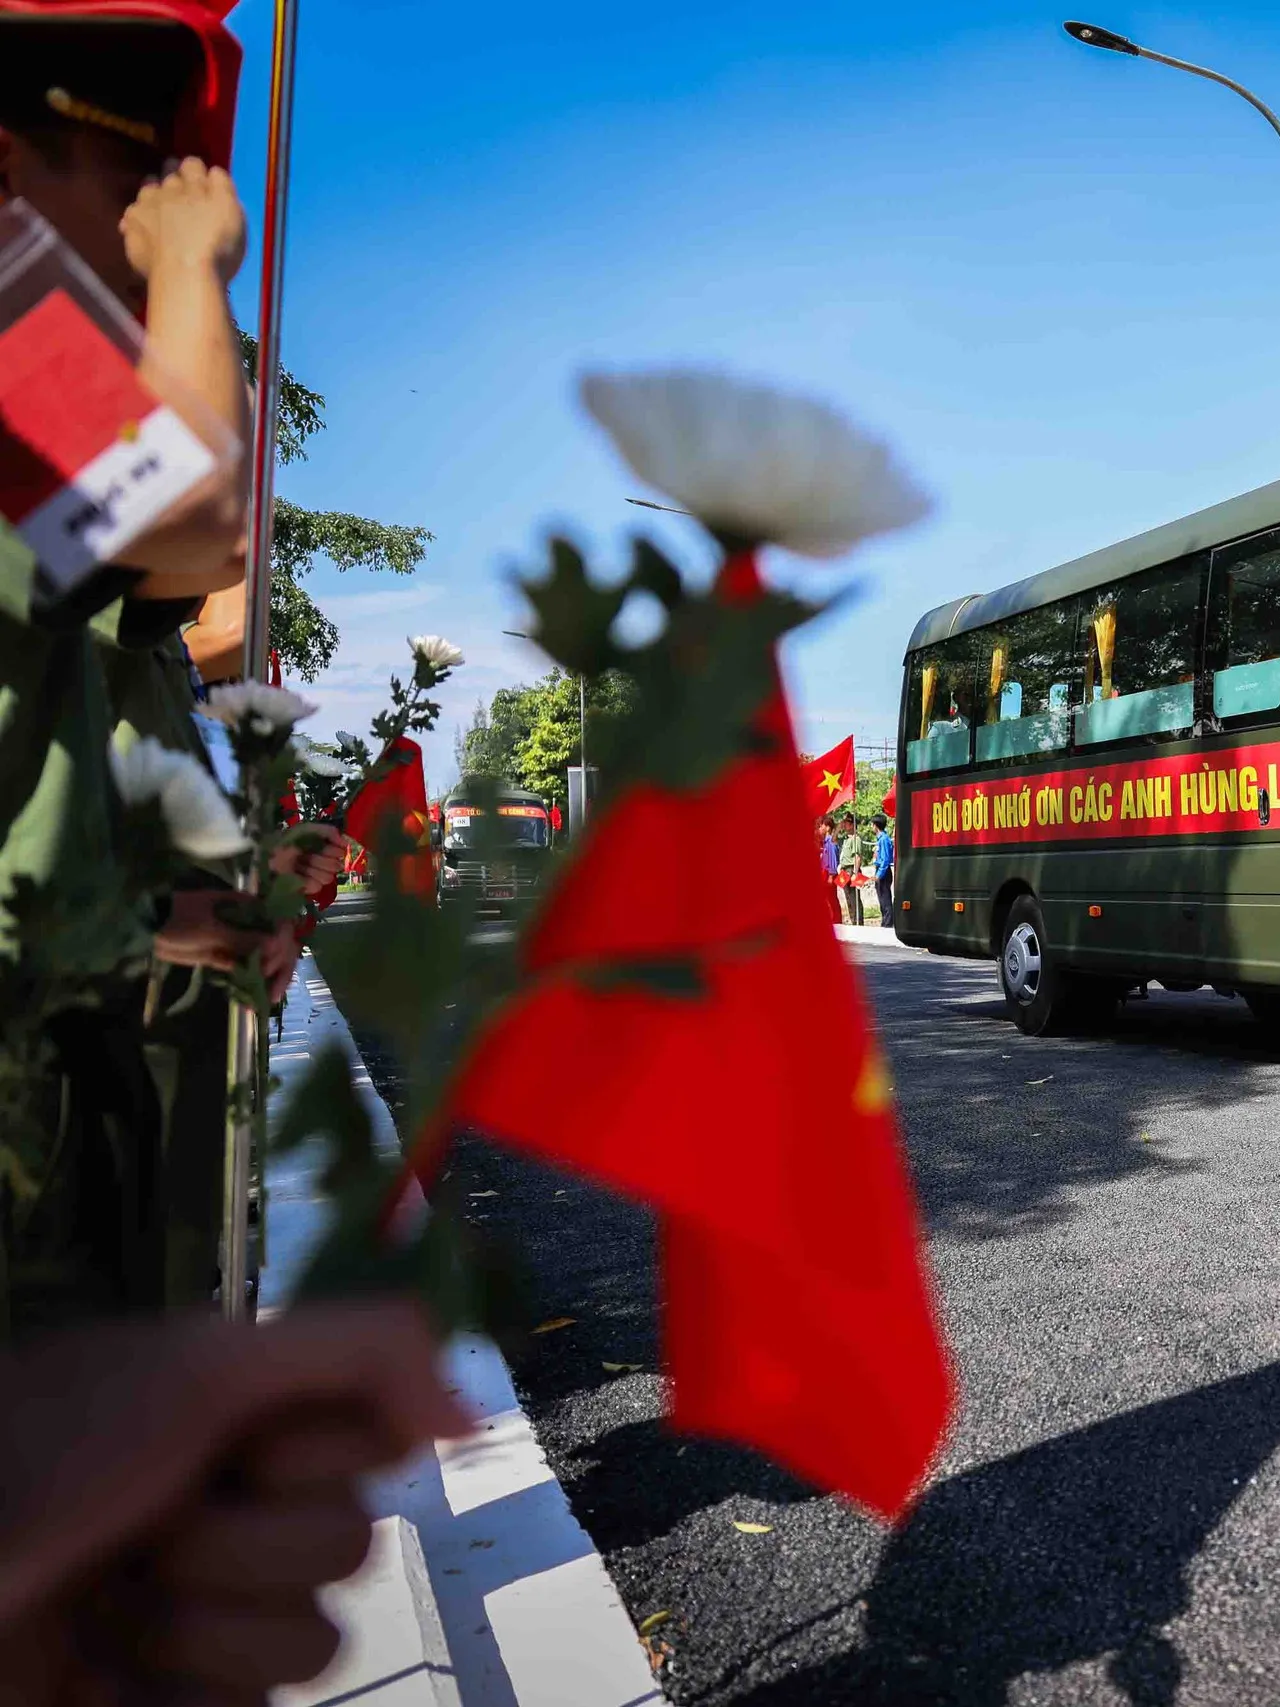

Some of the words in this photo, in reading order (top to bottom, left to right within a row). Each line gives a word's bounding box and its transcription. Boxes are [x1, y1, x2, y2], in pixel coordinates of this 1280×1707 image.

[932, 792, 958, 834] ĐỜI
[961, 789, 989, 832] ĐỜI
[993, 784, 1031, 829] NHỚ
[1036, 785, 1064, 825] ƠN
[1070, 776, 1113, 824] CÁC
[1120, 776, 1172, 820] ANH
[1180, 762, 1258, 816] HÙNG
